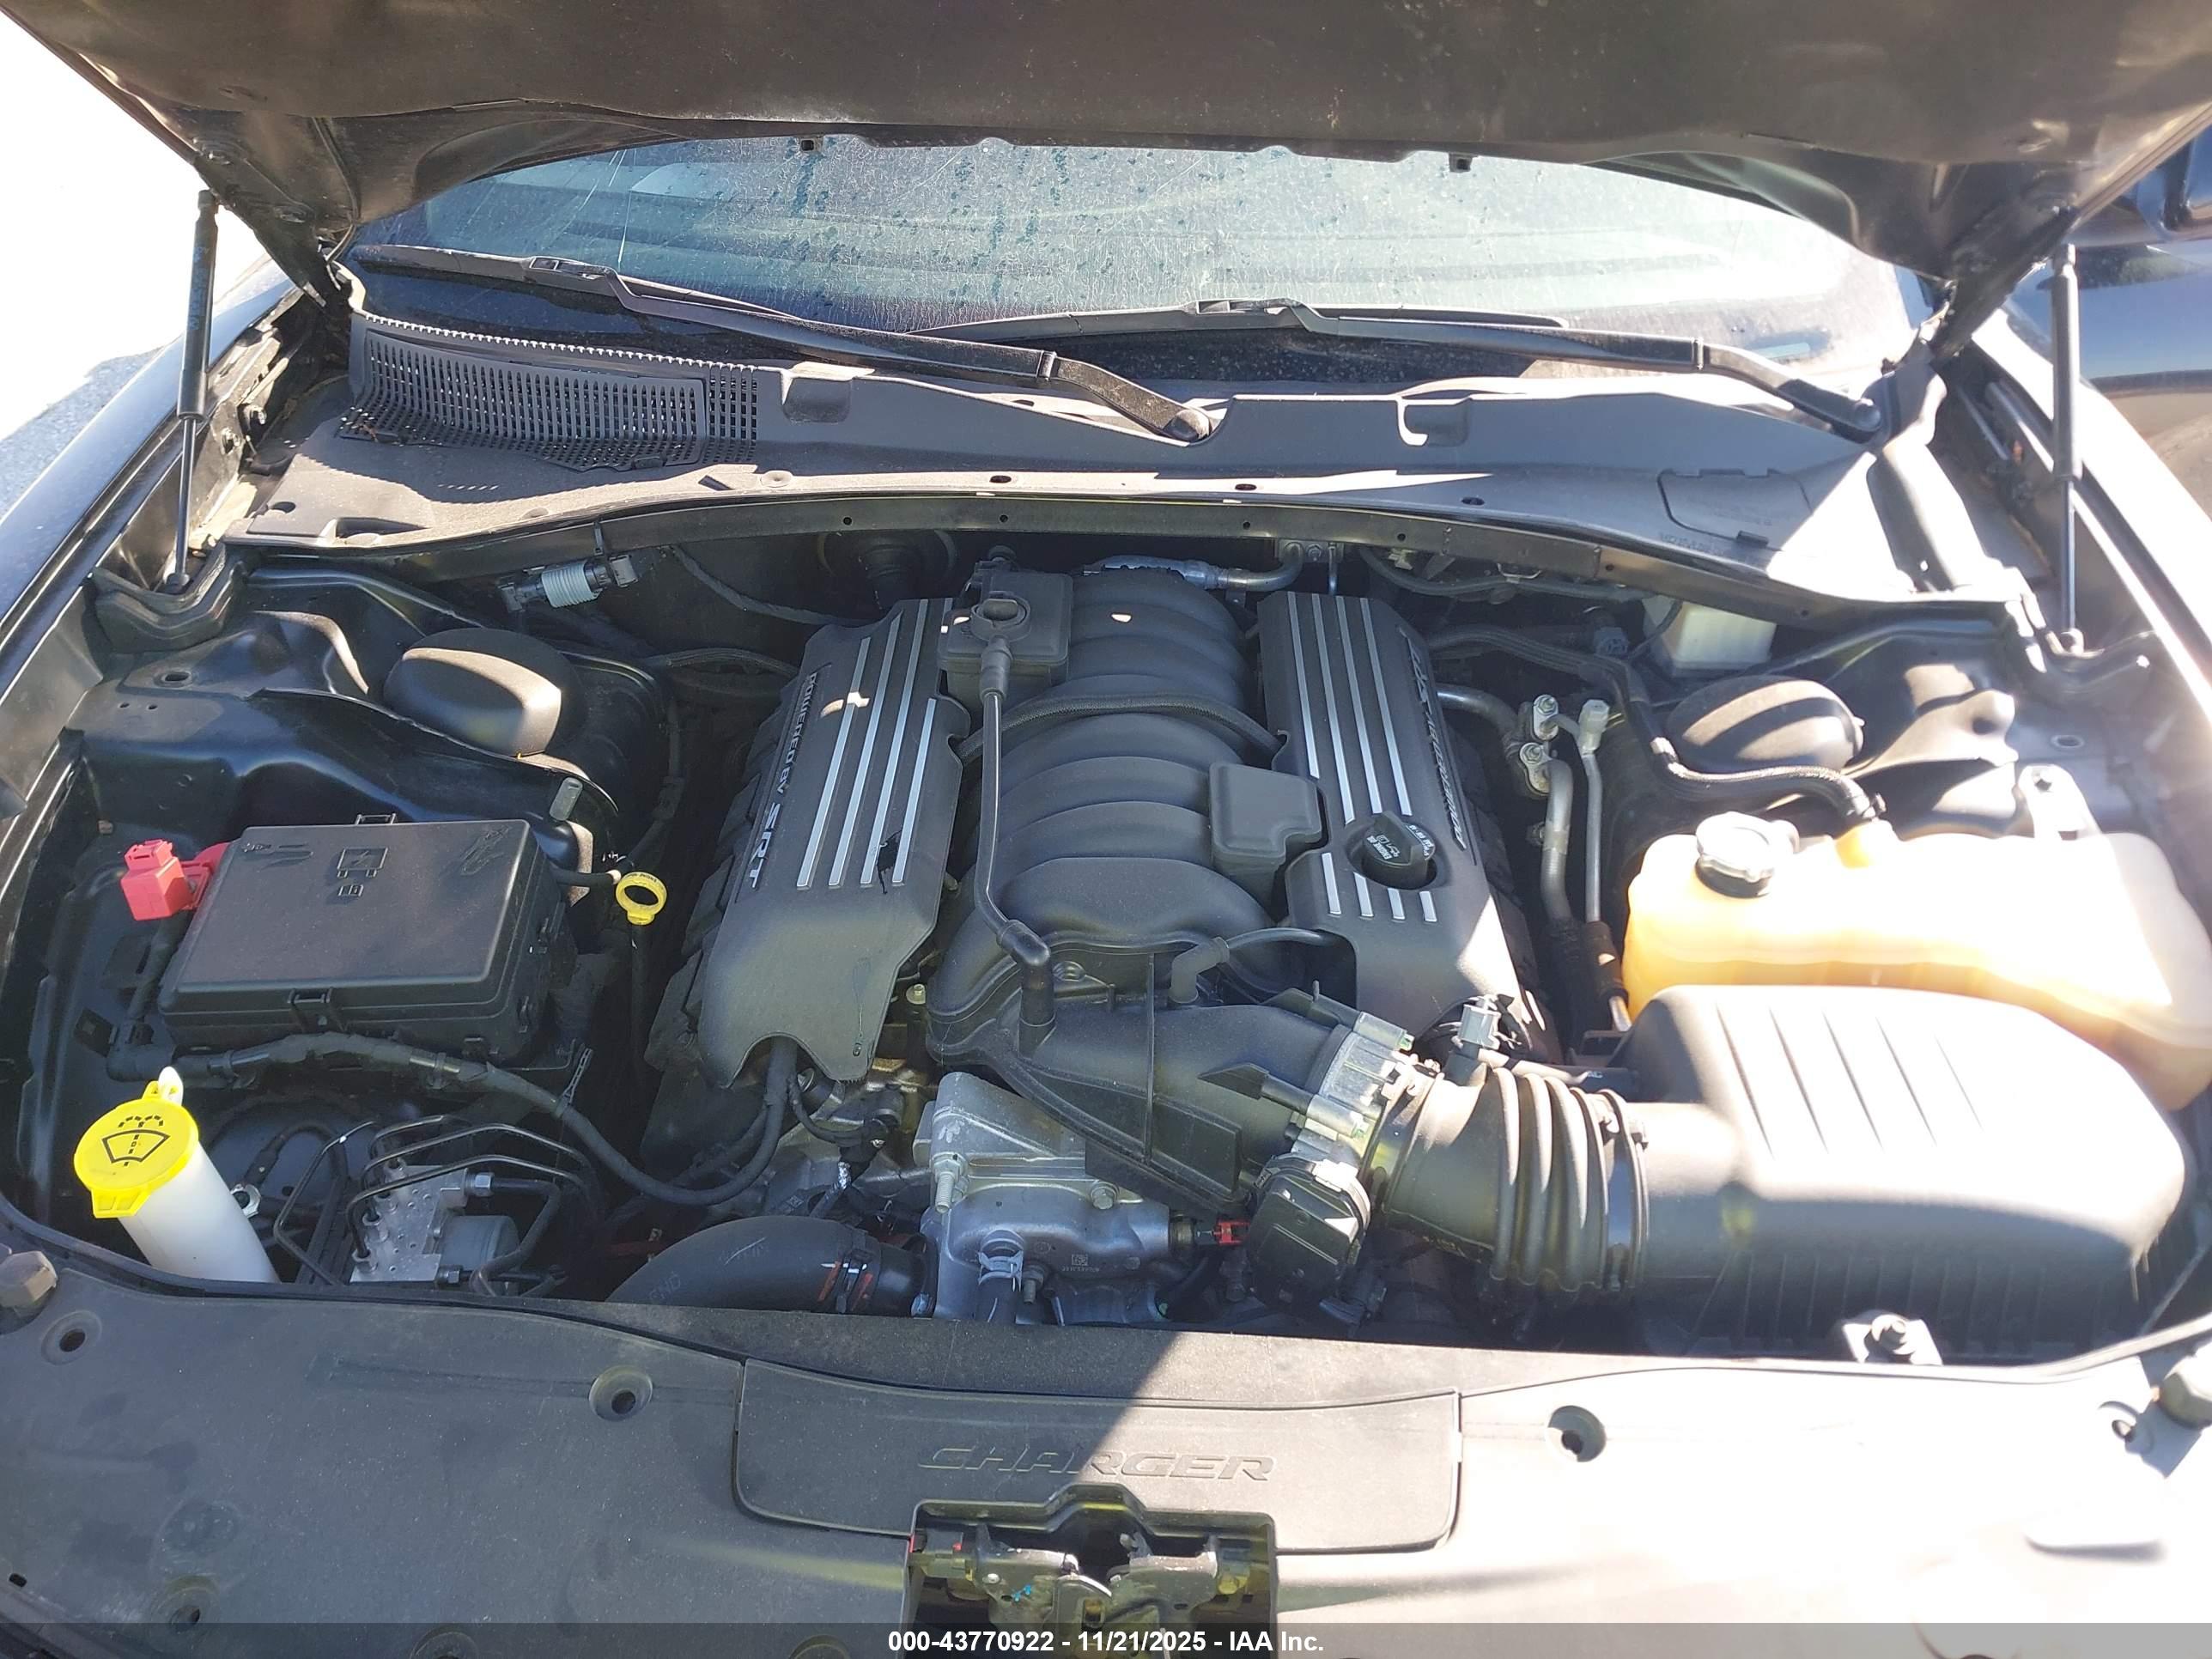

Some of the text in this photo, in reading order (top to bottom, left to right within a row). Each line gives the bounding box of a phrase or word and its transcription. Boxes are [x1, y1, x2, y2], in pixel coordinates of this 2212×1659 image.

[750, 672, 817, 888] POWERED BY SRT
[918, 1446, 1276, 1481] CHARGER
